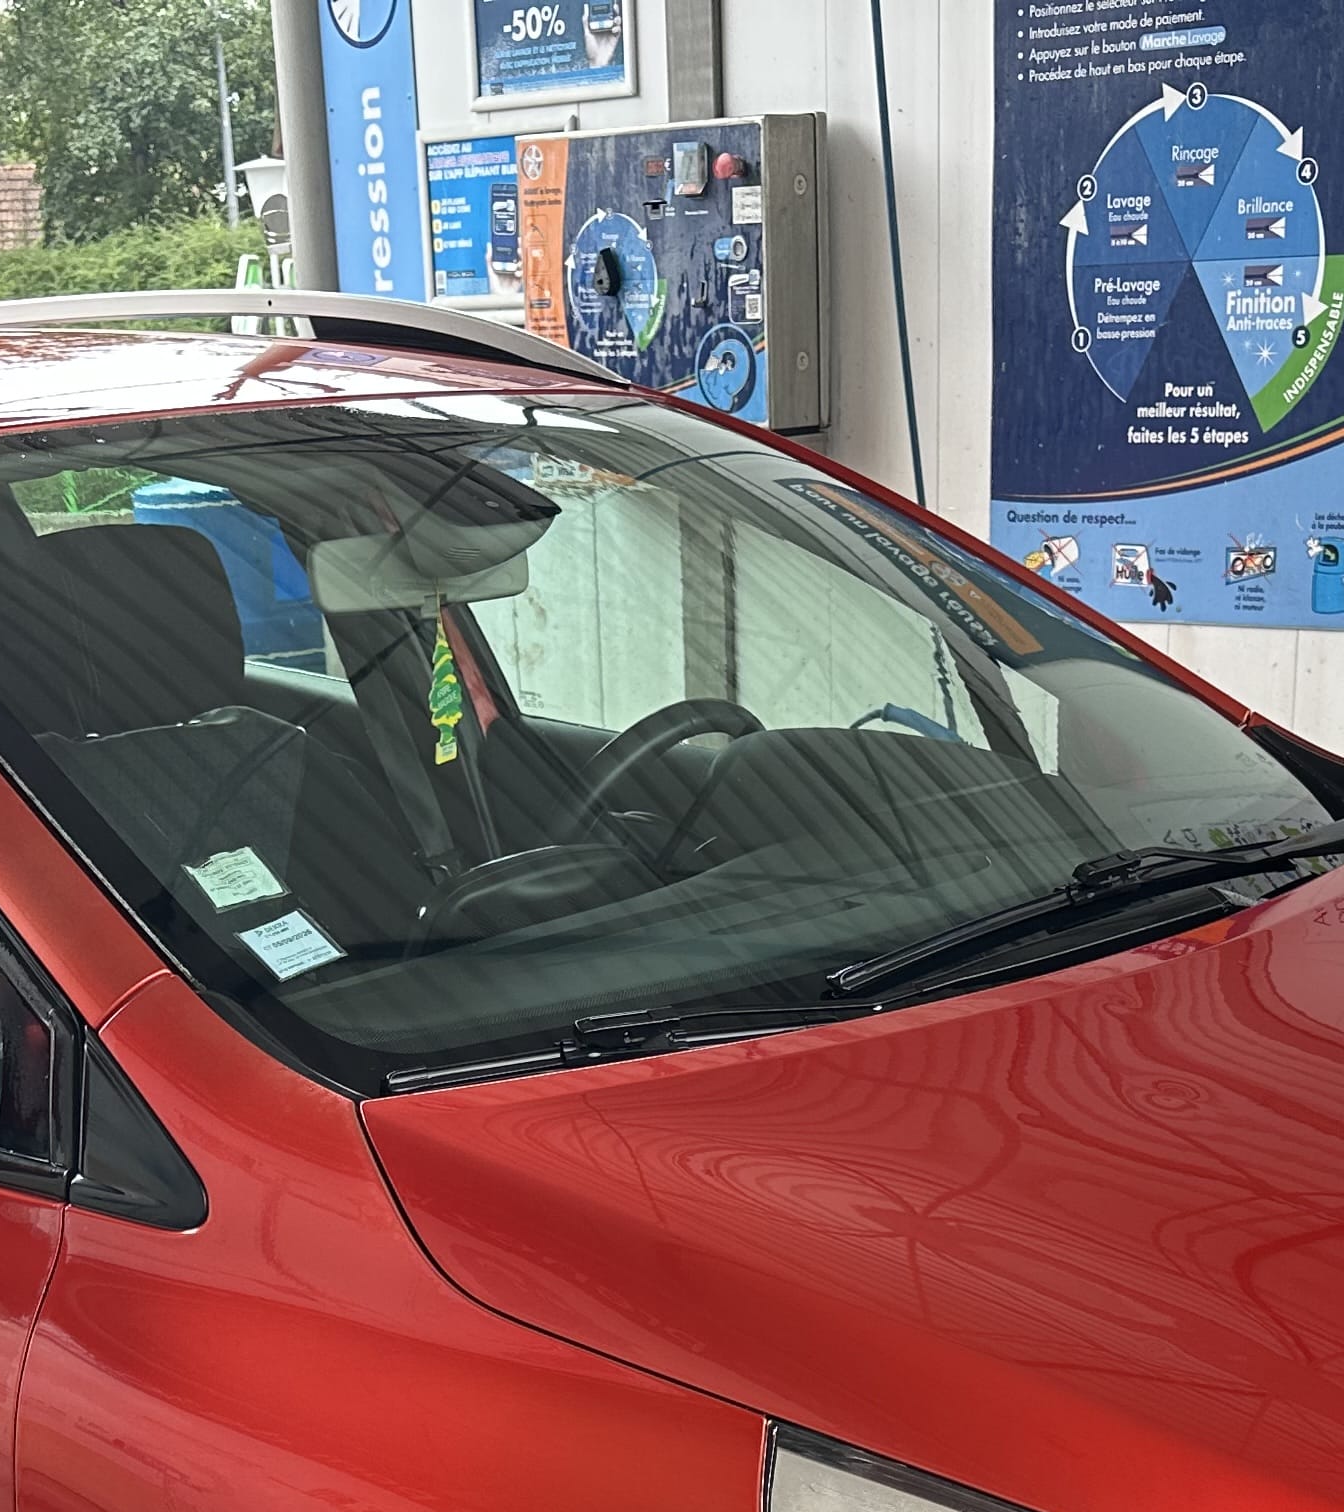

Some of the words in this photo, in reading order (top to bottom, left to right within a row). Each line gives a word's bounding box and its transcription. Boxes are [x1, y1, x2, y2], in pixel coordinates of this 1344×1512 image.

[1029, 2, 1083, 18] Positionnez
[503, 4, 565, 41] -50%
[1029, 22, 1081, 39] Introduisez
[1083, 20, 1107, 33] votre
[1109, 14, 1137, 30] mode
[1140, 12, 1153, 27] de
[1155, 9, 1205, 30] paiement.
[1028, 48, 1072, 64] Appuyez
[1074, 46, 1089, 57] sur
[1091, 40, 1100, 54] le
[1102, 39, 1136, 53] bouton
[1142, 32, 1186, 48] Marche
[1187, 31, 1225, 46] Lavage
[1029, 65, 1072, 82] Procédez
[1074, 62, 1087, 78] de
[1089, 62, 1111, 76] haut
[1112, 64, 1125, 74] en
[1128, 58, 1146, 72] bas
[1148, 59, 1172, 74] pour
[1175, 52, 1212, 70] chaque
[1214, 50, 1247, 67] étape.
[1171, 145, 1219, 164] Rinçage
[358, 86, 394, 292] ression
[1108, 194, 1152, 211] Lavage
[1238, 198, 1294, 216] Brillance
[1109, 212, 1122, 222] Eau
[1123, 211, 1149, 221] chaude
[1094, 277, 1160, 296] Pré-Lavage
[1107, 296, 1121, 306] Eau
[1226, 289, 1296, 315] Finition
[1098, 312, 1143, 326] Détrempez
[1145, 314, 1156, 322] en
[1226, 314, 1293, 332] Anti-traces
[1121, 328, 1156, 342] pression
[1296, 329, 1306, 344] 5
[1282, 291, 1344, 404] INDISPENSABLE
[1165, 382, 1194, 398] Pour
[1197, 386, 1213, 397] un
[1137, 403, 1187, 418] meilleur
[1190, 402, 1240, 420] résultat,
[1128, 426, 1164, 444] faites
[1167, 427, 1186, 443] les
[1190, 428, 1200, 442] 5
[1203, 426, 1248, 448] étapes
[1007, 510, 1058, 524] Question
[1063, 510, 1078, 524] de
[1082, 512, 1136, 528] respect...
